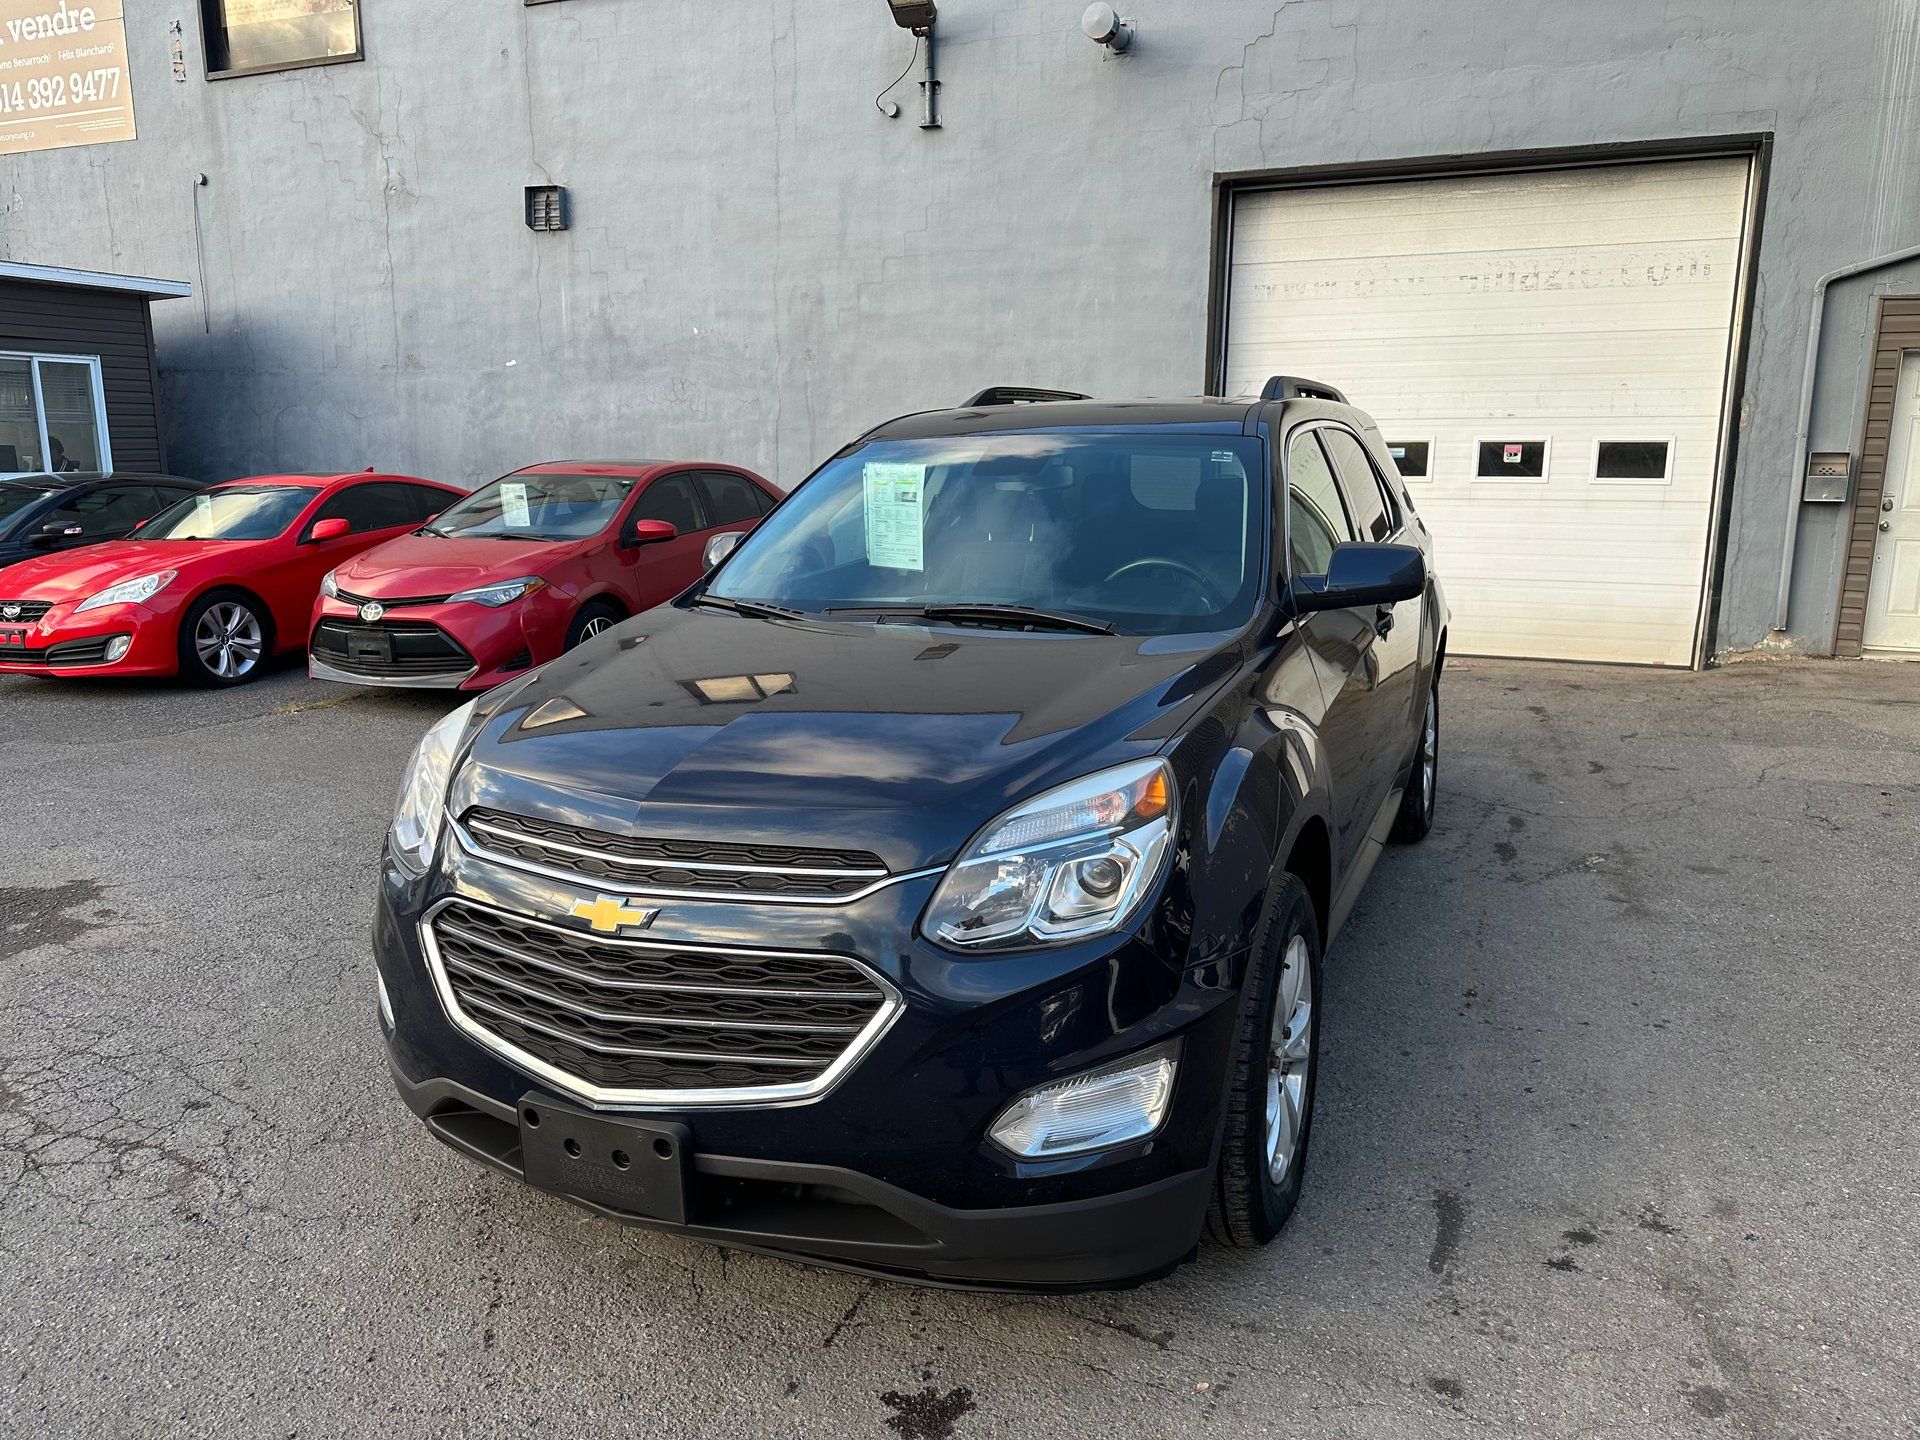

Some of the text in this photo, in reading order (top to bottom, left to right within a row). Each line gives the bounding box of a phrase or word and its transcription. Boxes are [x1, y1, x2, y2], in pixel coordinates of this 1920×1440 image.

[6, 0, 96, 43] vendre
[0, 61, 12, 70] mo
[58, 49, 75, 61] Félix
[0, 67, 120, 113] 14 392 9477
